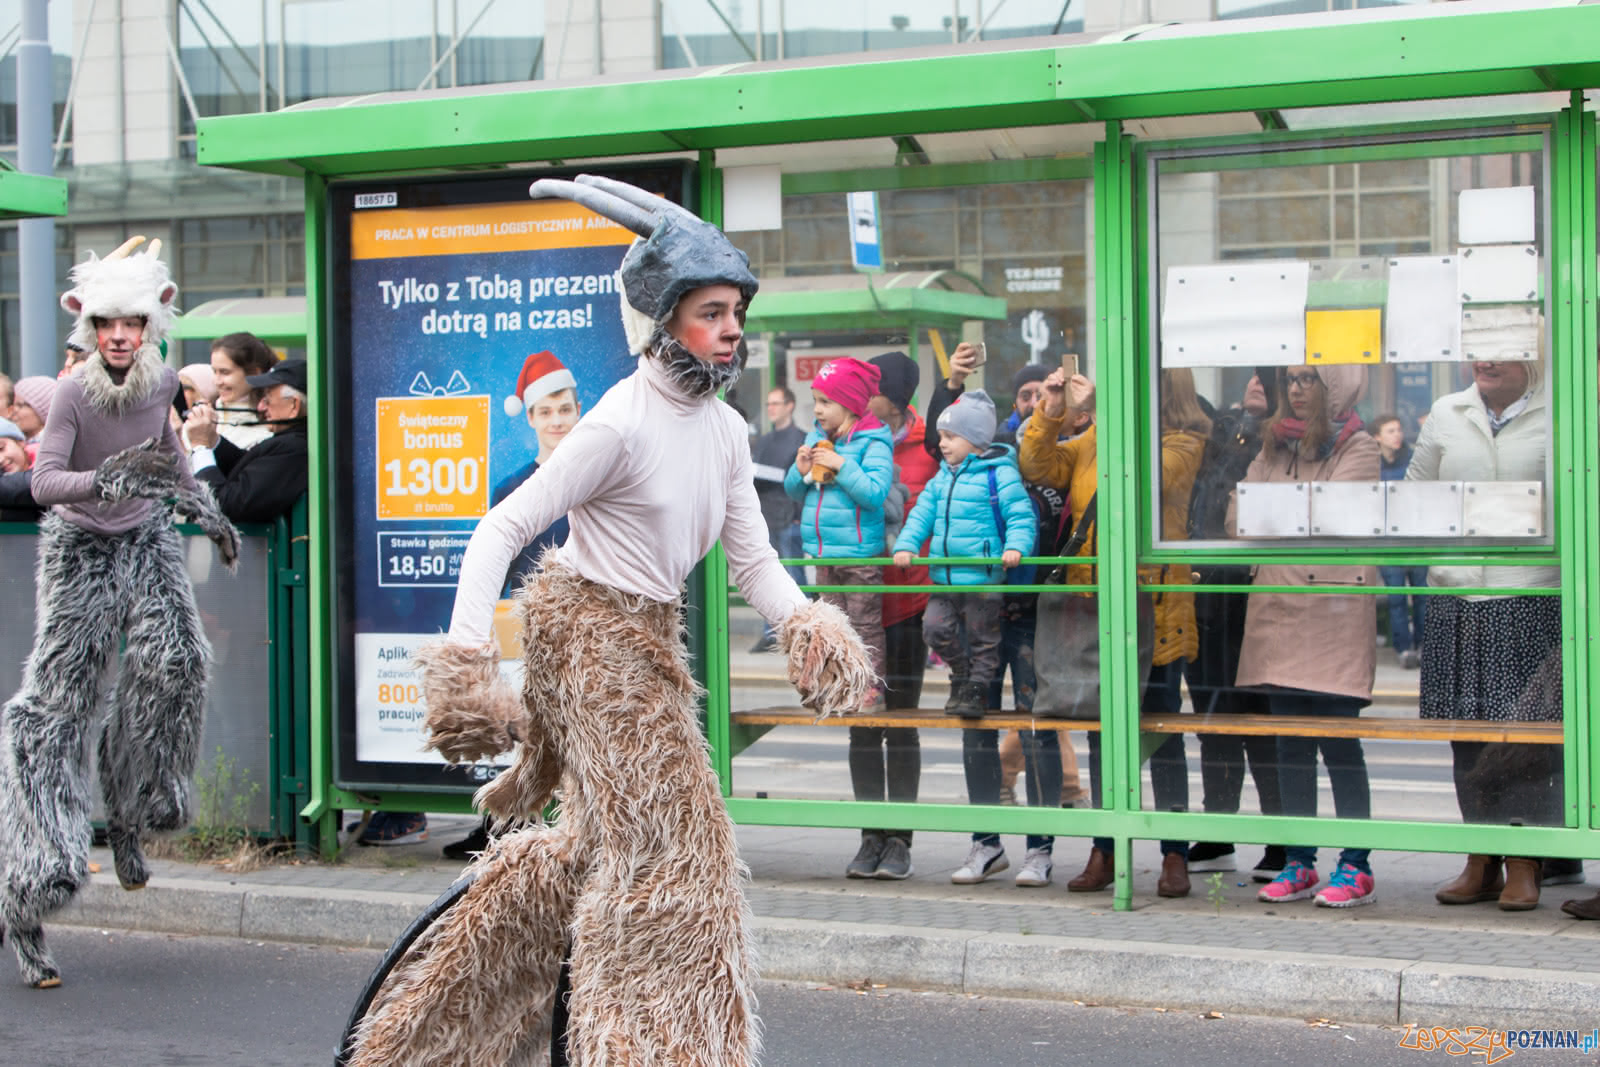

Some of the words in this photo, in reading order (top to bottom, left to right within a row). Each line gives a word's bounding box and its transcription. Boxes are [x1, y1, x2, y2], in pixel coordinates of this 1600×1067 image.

[387, 194, 394, 204] D
[375, 228, 413, 241] PRACA
[416, 227, 428, 239] W
[431, 223, 491, 239] CENTRUM
[493, 218, 583, 235] LOGISTYCZNYM
[378, 278, 439, 309] Tylko
[446, 282, 460, 301] z
[465, 274, 522, 304] Tobą
[421, 309, 487, 338] dotrą
[494, 311, 521, 331] na
[528, 303, 593, 330] czas!
[398, 412, 468, 430] Świąteczny
[403, 429, 464, 449] bonus
[425, 501, 455, 513] brutto
[390, 537, 427, 548] Stawka
[389, 554, 446, 580] 18,50
[378, 683, 419, 704] 800
